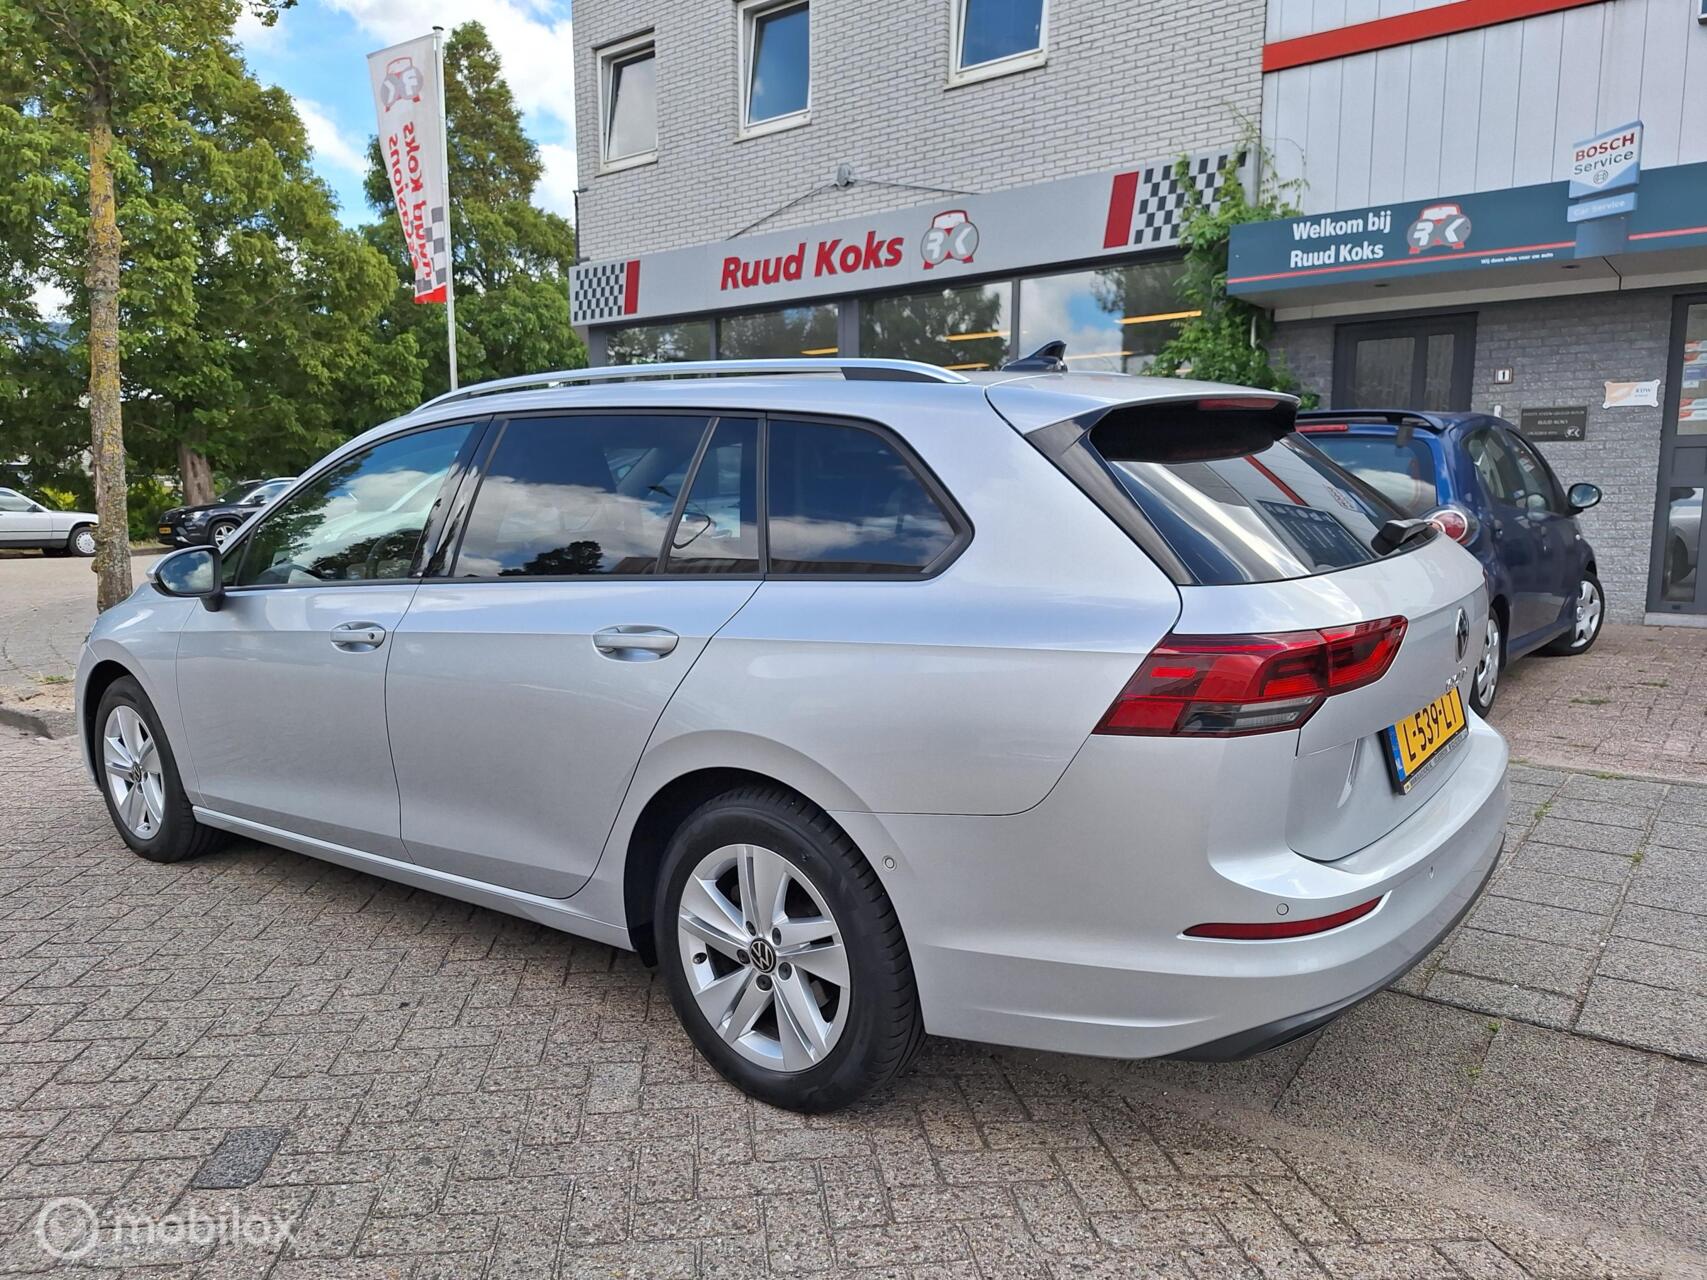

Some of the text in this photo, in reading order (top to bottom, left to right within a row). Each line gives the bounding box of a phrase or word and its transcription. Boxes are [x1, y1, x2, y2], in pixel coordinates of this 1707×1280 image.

[1575, 132, 1635, 162] BOSCH
[1574, 151, 1634, 175] Service
[1293, 210, 1392, 240] Welkom bij
[720, 230, 904, 291] Ruud Koks
[1290, 240, 1384, 268] Ruud Koks
